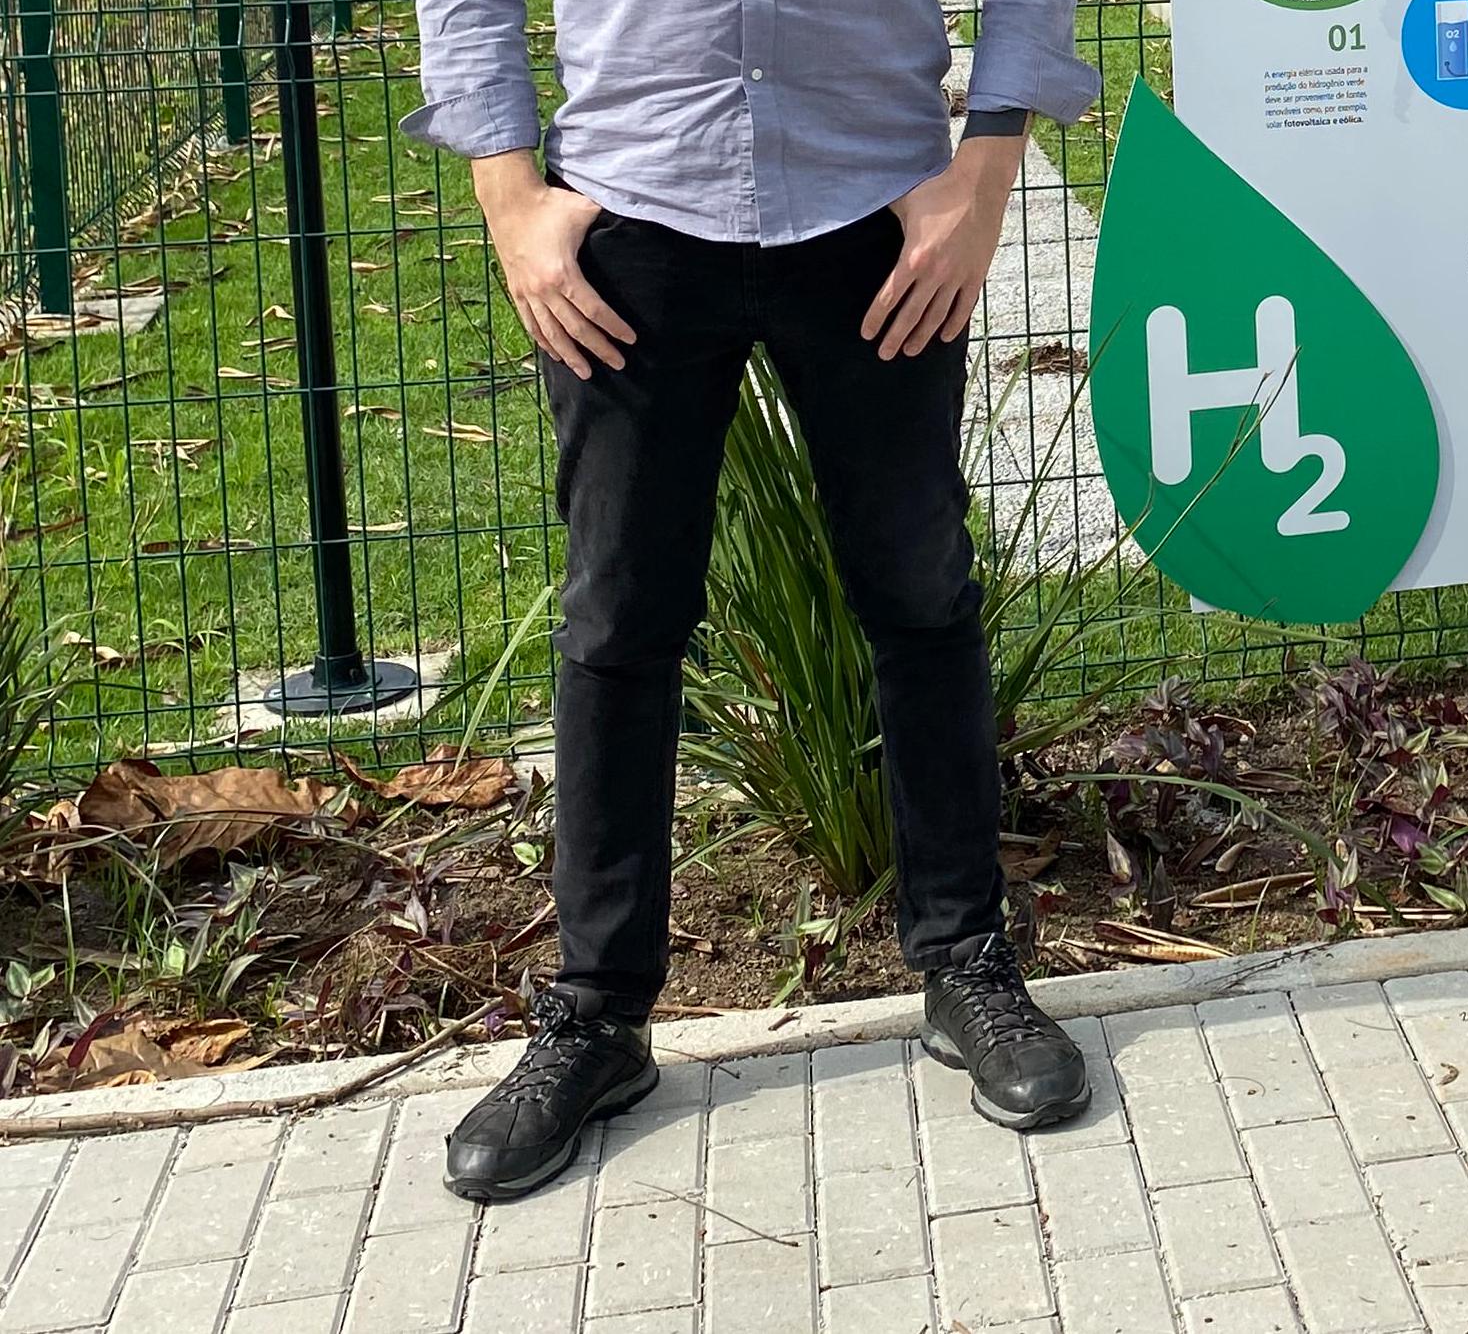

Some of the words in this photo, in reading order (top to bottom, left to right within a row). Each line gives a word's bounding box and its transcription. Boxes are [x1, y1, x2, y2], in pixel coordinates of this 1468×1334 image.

[1328, 23, 1366, 52] 01
[1446, 29, 1460, 38] O2
[1146, 295, 1351, 536] H2
